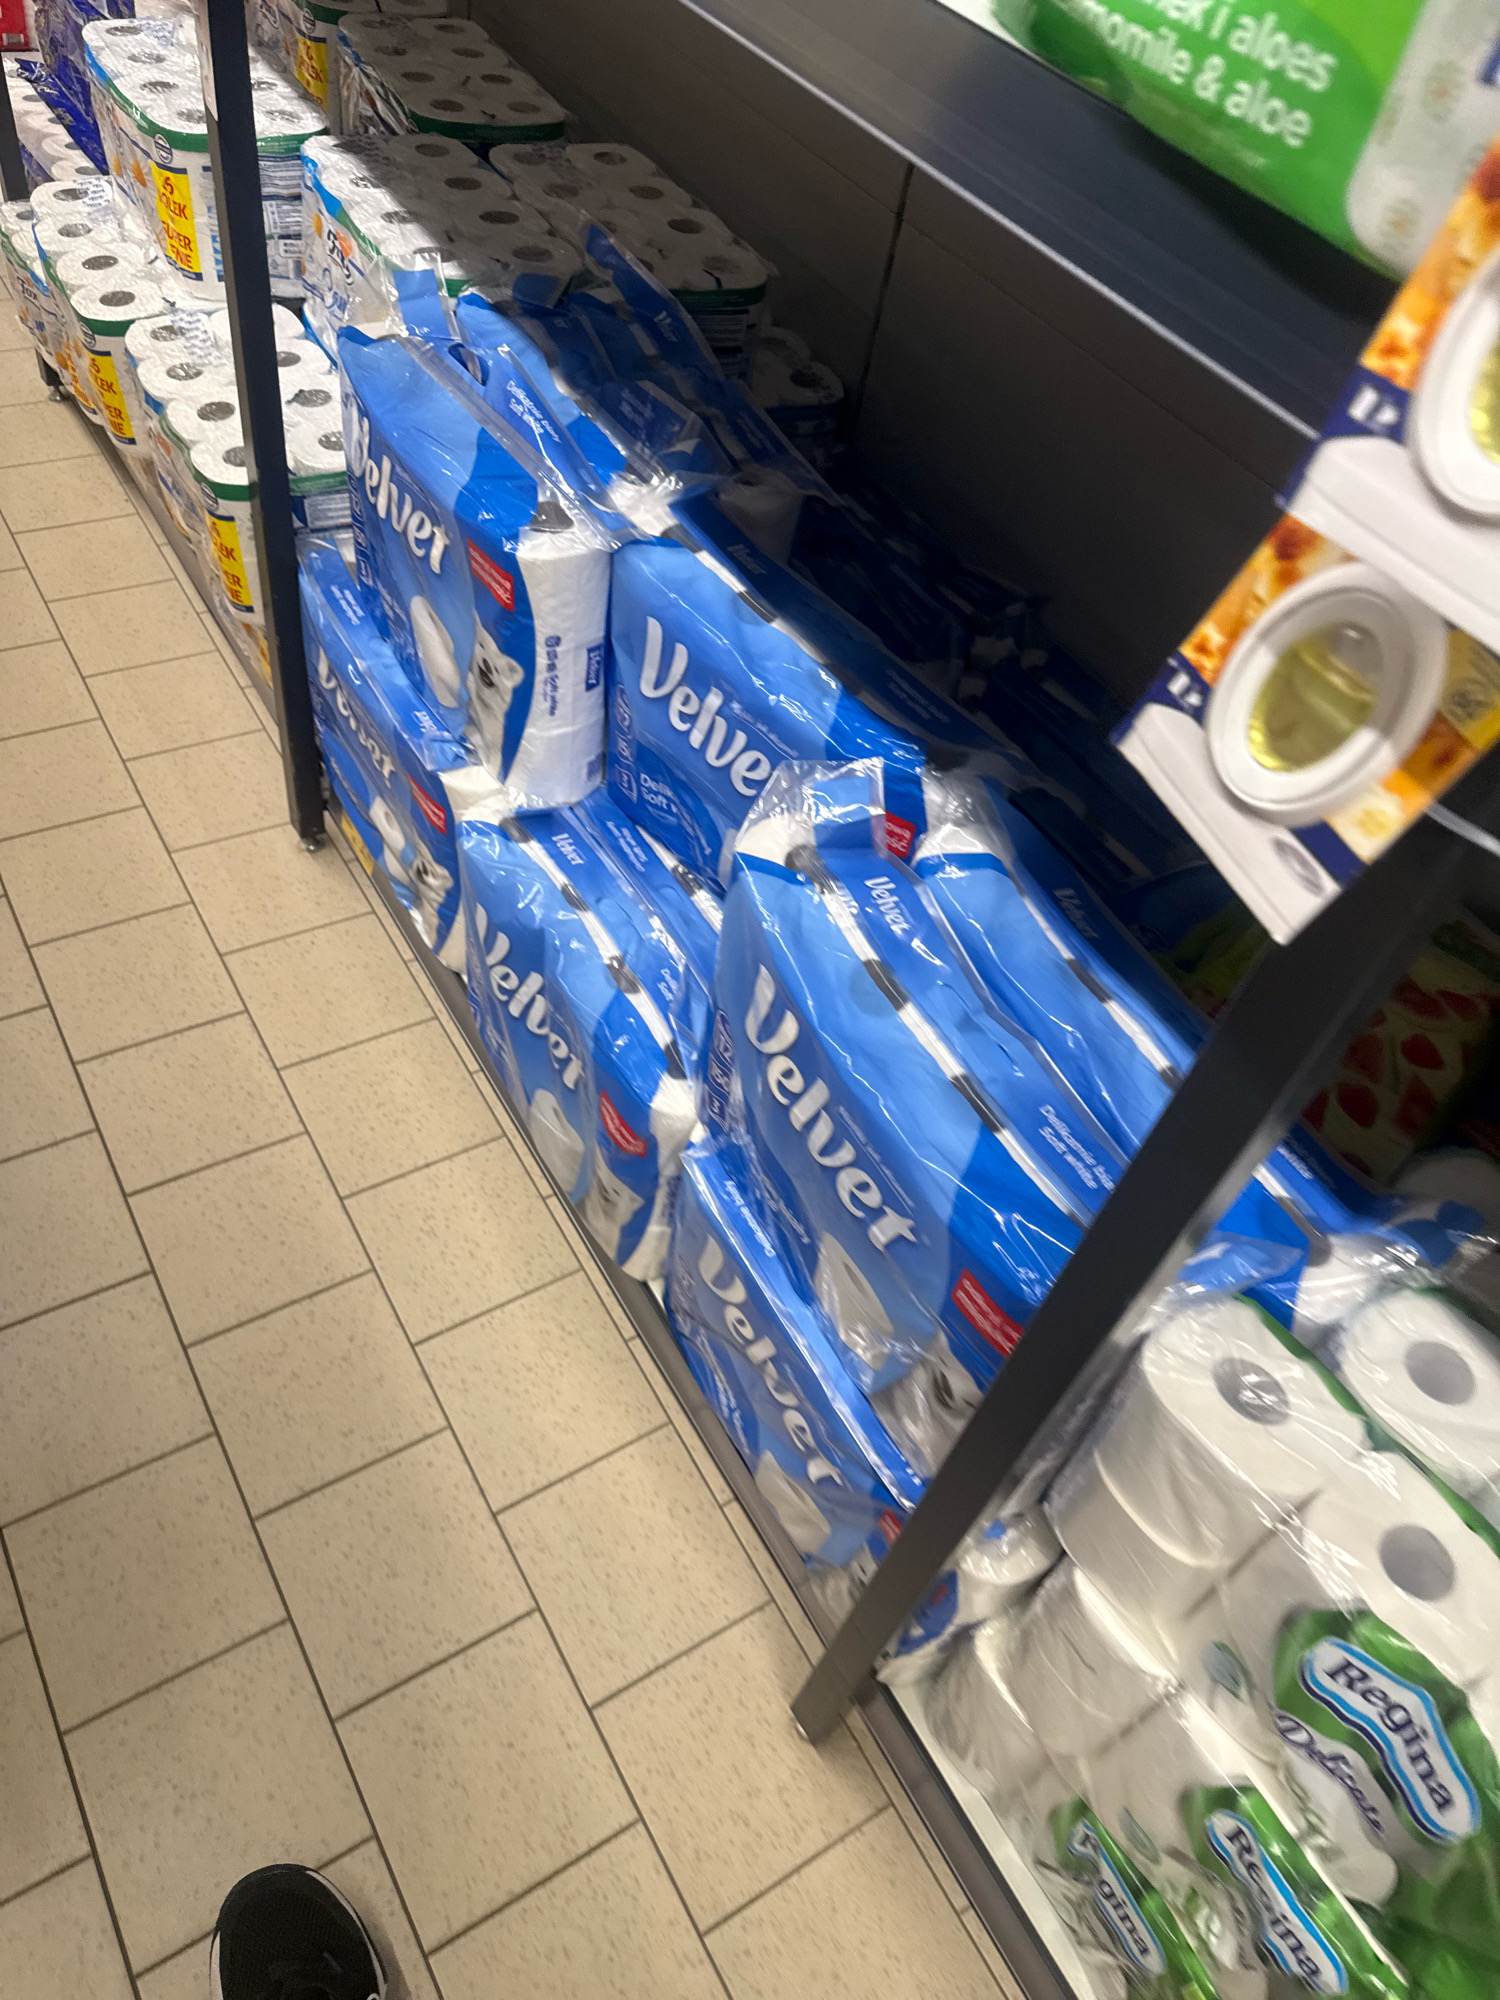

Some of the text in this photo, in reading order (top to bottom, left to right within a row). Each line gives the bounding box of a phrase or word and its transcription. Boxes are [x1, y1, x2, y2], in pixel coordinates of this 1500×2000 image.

[1194, 54, 1227, 103] &
[1223, 74, 1313, 149] aloe
[1227, 12, 1337, 92] aloes
[346, 395, 450, 575] Velvet
[640, 616, 772, 797] Velve
[863, 876, 911, 937] Velvet
[746, 963, 918, 1254] Velvet
[1037, 1125, 1099, 1190] Soft white
[1324, 1656, 1458, 1818] Regina
